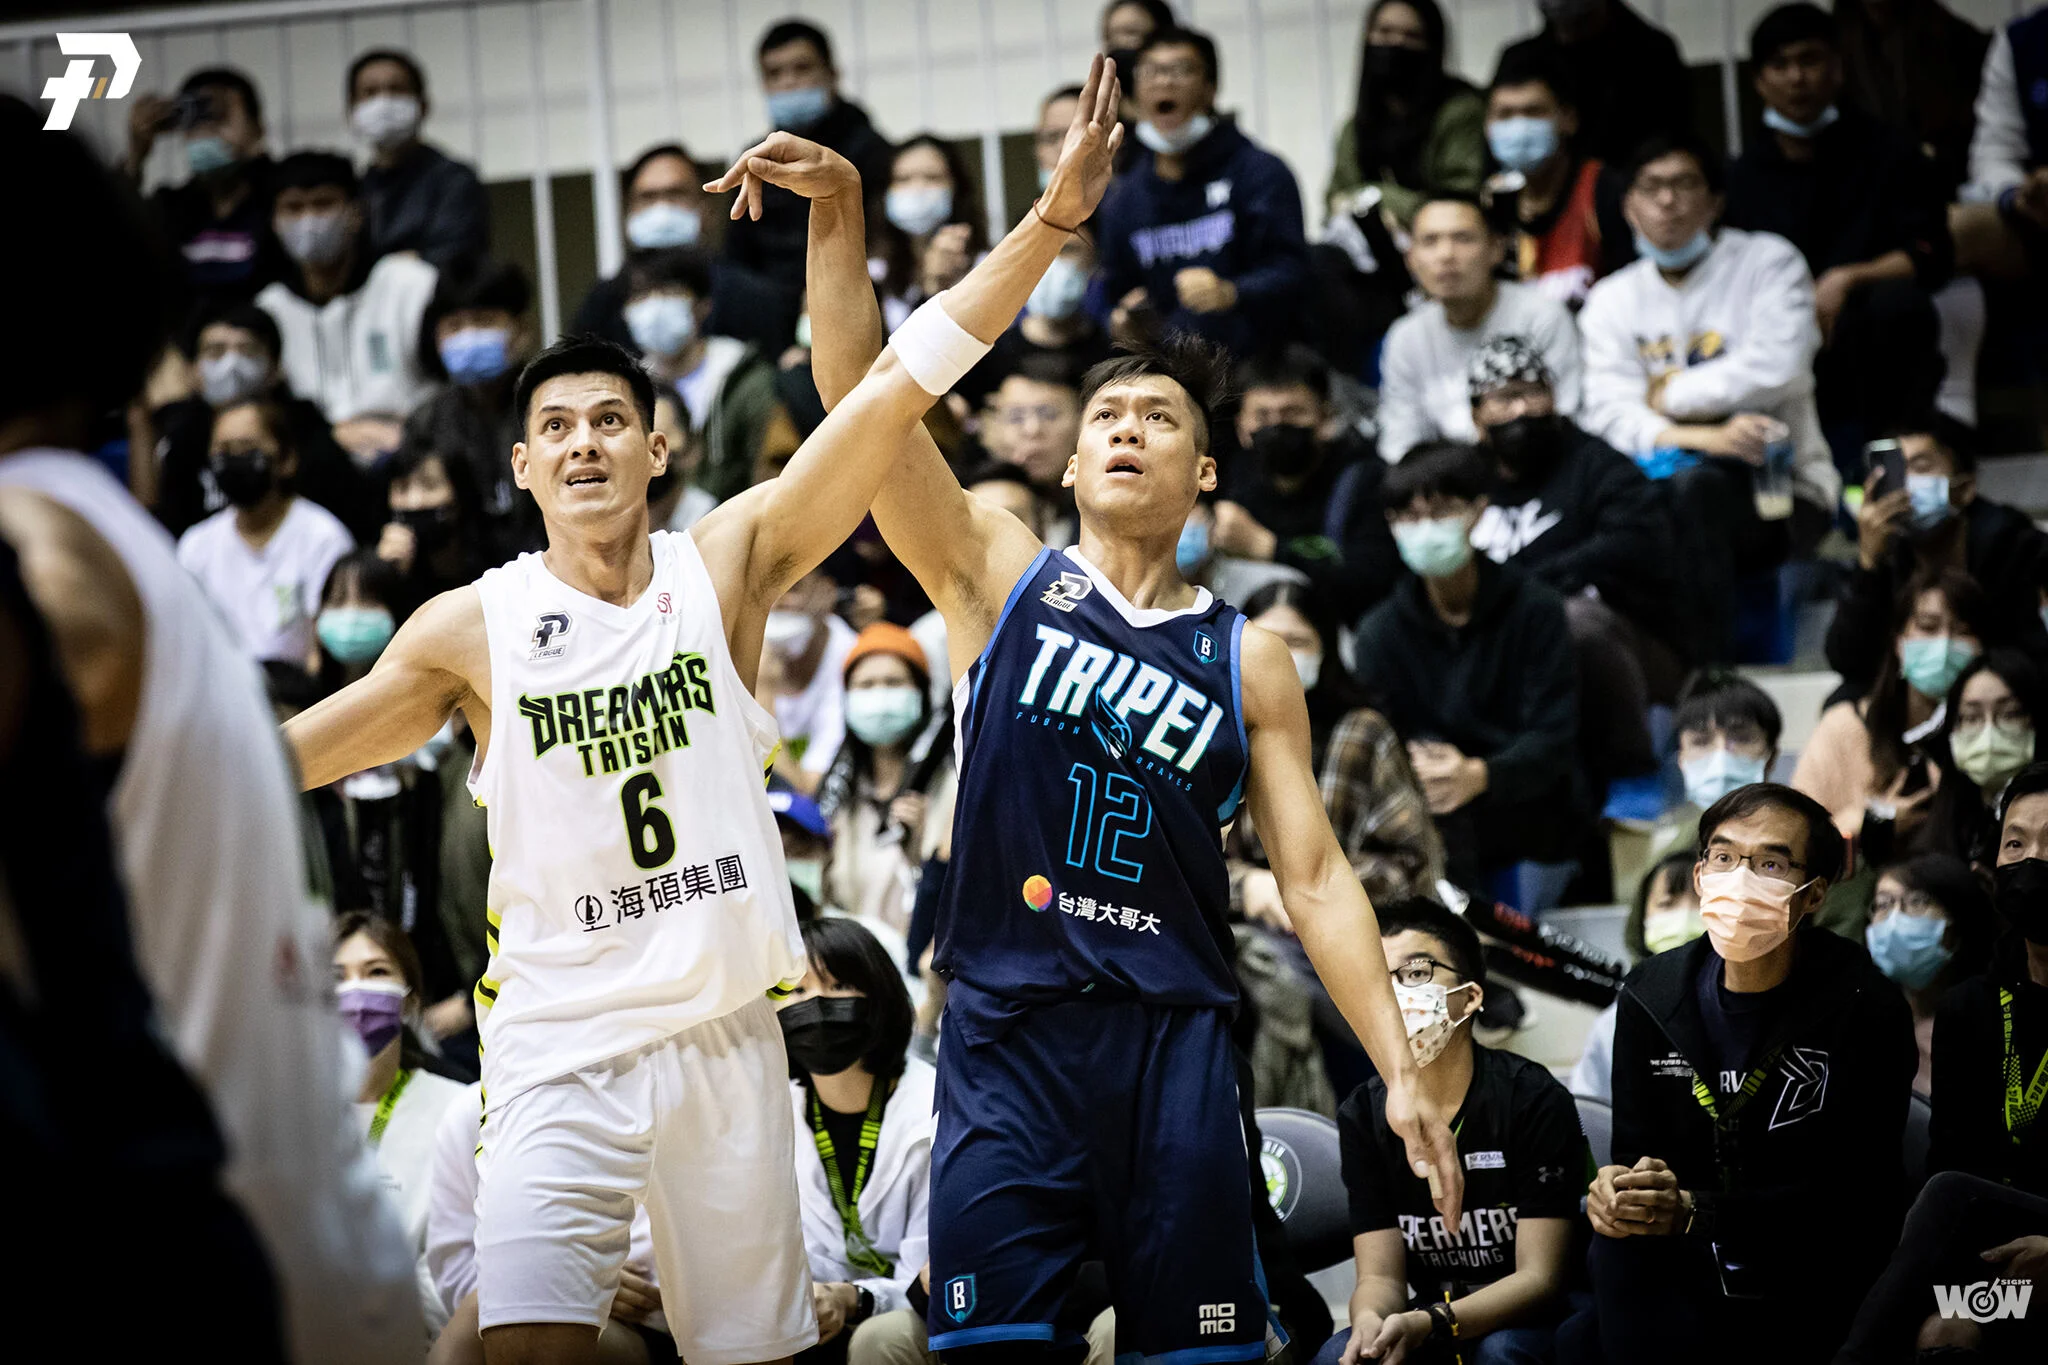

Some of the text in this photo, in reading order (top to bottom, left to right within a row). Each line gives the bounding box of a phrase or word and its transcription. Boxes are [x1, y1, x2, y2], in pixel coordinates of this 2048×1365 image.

[533, 647, 564, 659] LEAGUE
[1018, 623, 1224, 774] TAIPEI
[1016, 711, 1193, 793] FUBON BRAVES
[620, 769, 677, 872] 6
[1066, 762, 1153, 884] 12
[611, 854, 748, 924] 海碩集團
[1058, 891, 1161, 935] 台灣大哥大
[1398, 1207, 1518, 1251] REAMER
[1417, 1248, 1505, 1268] TAICHUNG
